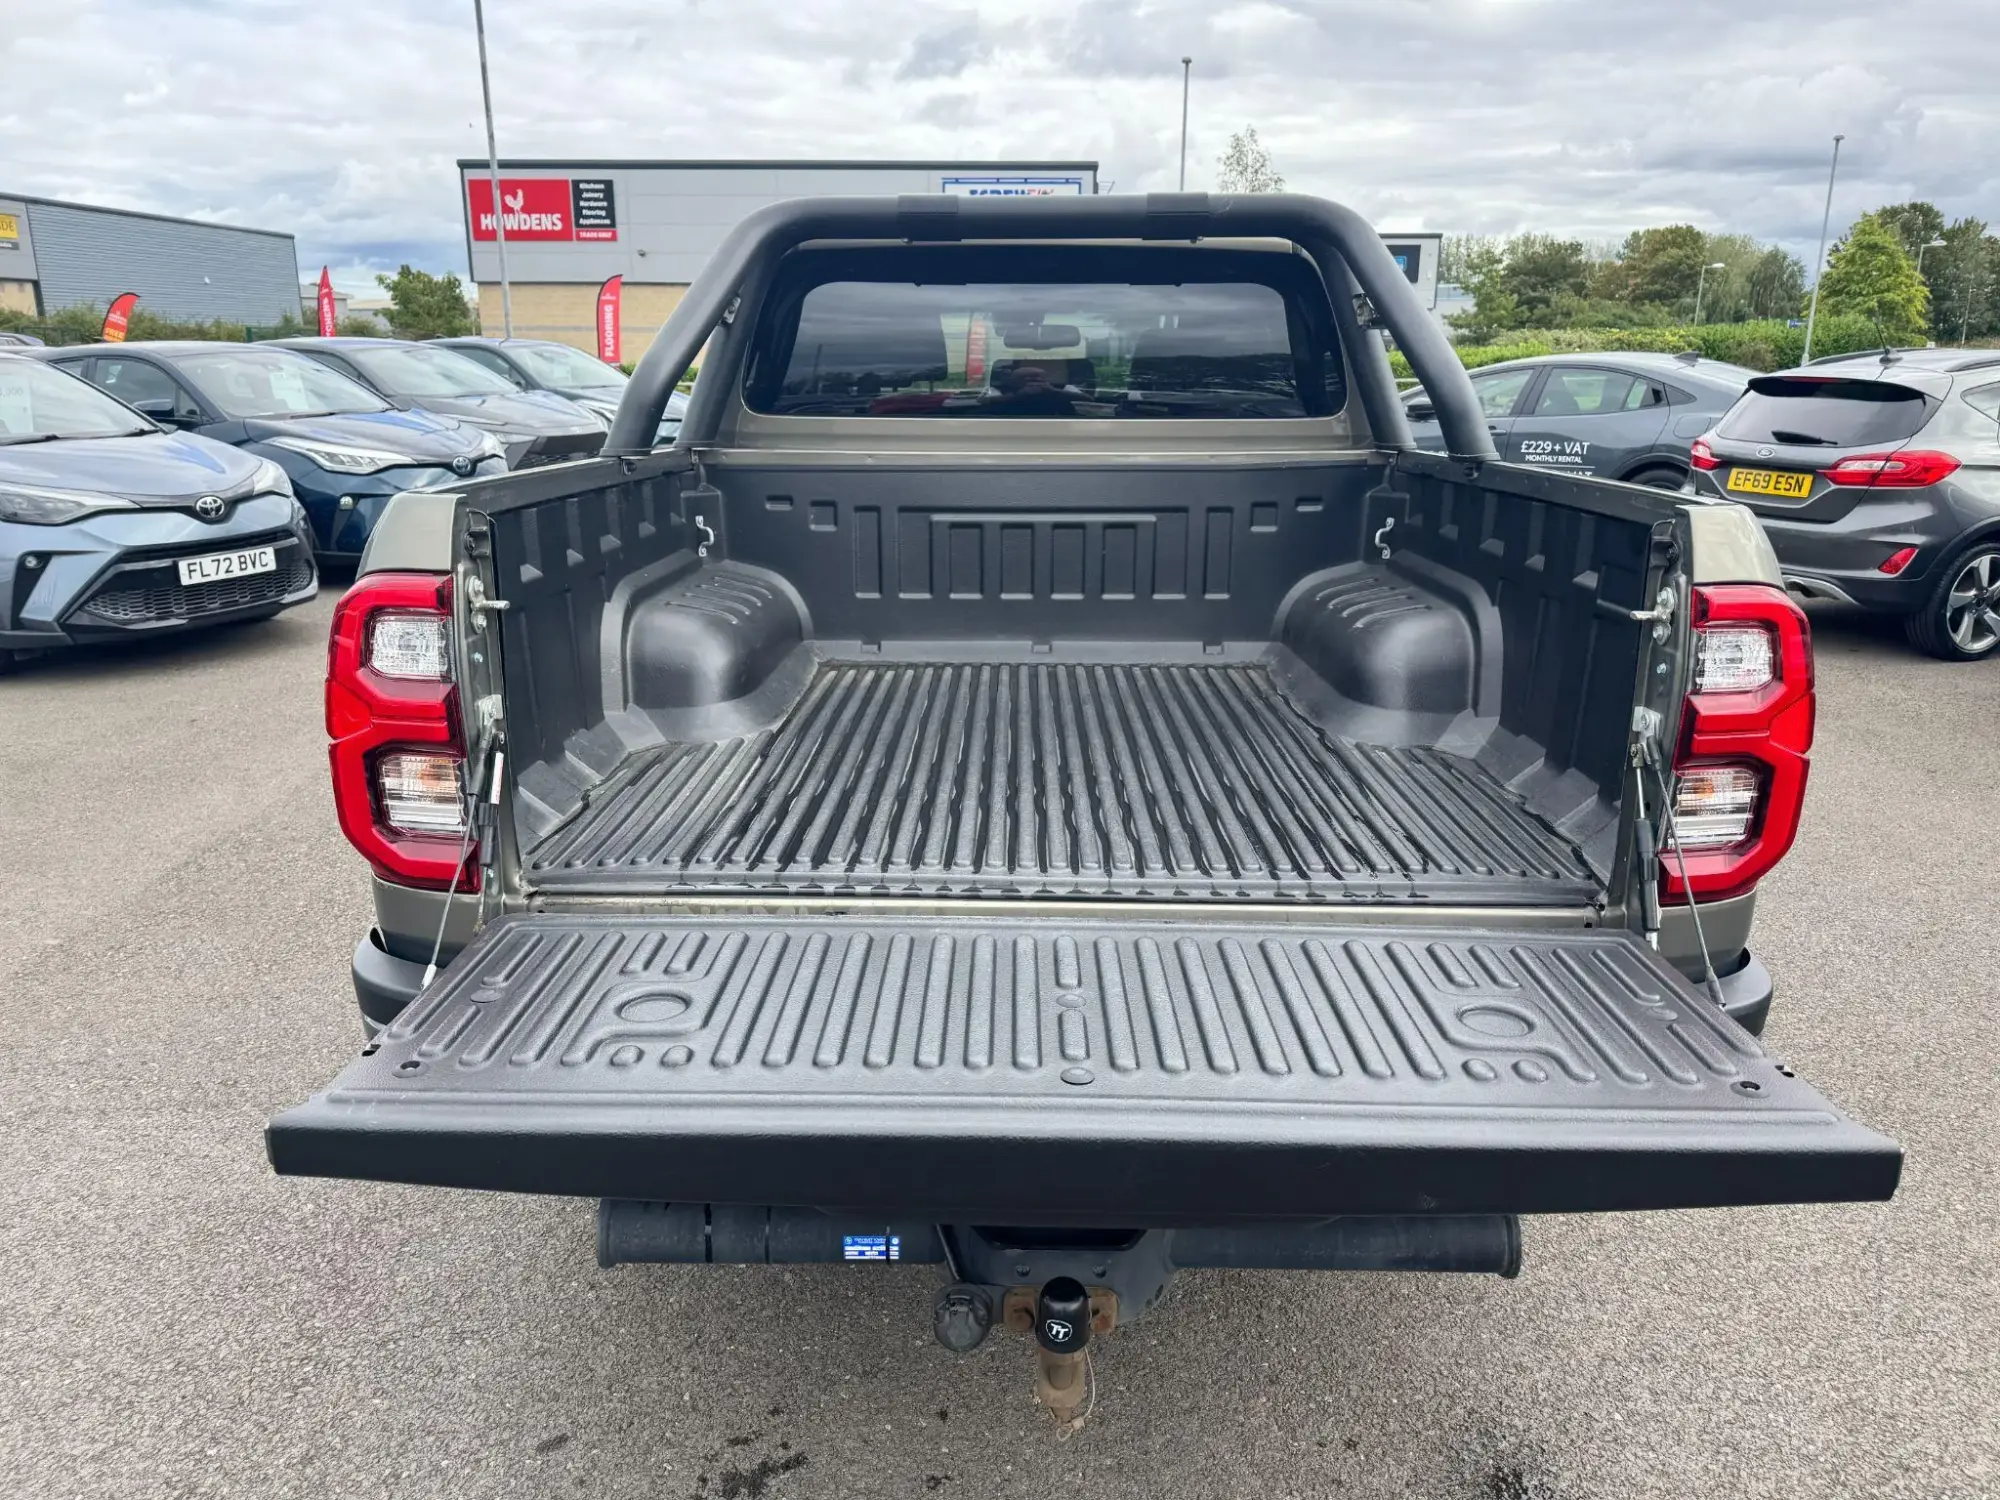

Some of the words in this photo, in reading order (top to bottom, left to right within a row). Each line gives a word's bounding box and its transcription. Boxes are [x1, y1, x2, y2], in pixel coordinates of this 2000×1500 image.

[604, 304, 614, 357] FLOORING
[1525, 454, 1558, 462] MONTHLY
[1564, 442, 1590, 455] VAT
[1733, 471, 1771, 489] EF69
[1774, 474, 1805, 492] ESN
[186, 557, 234, 580] FL72
[237, 551, 269, 571] BVC
